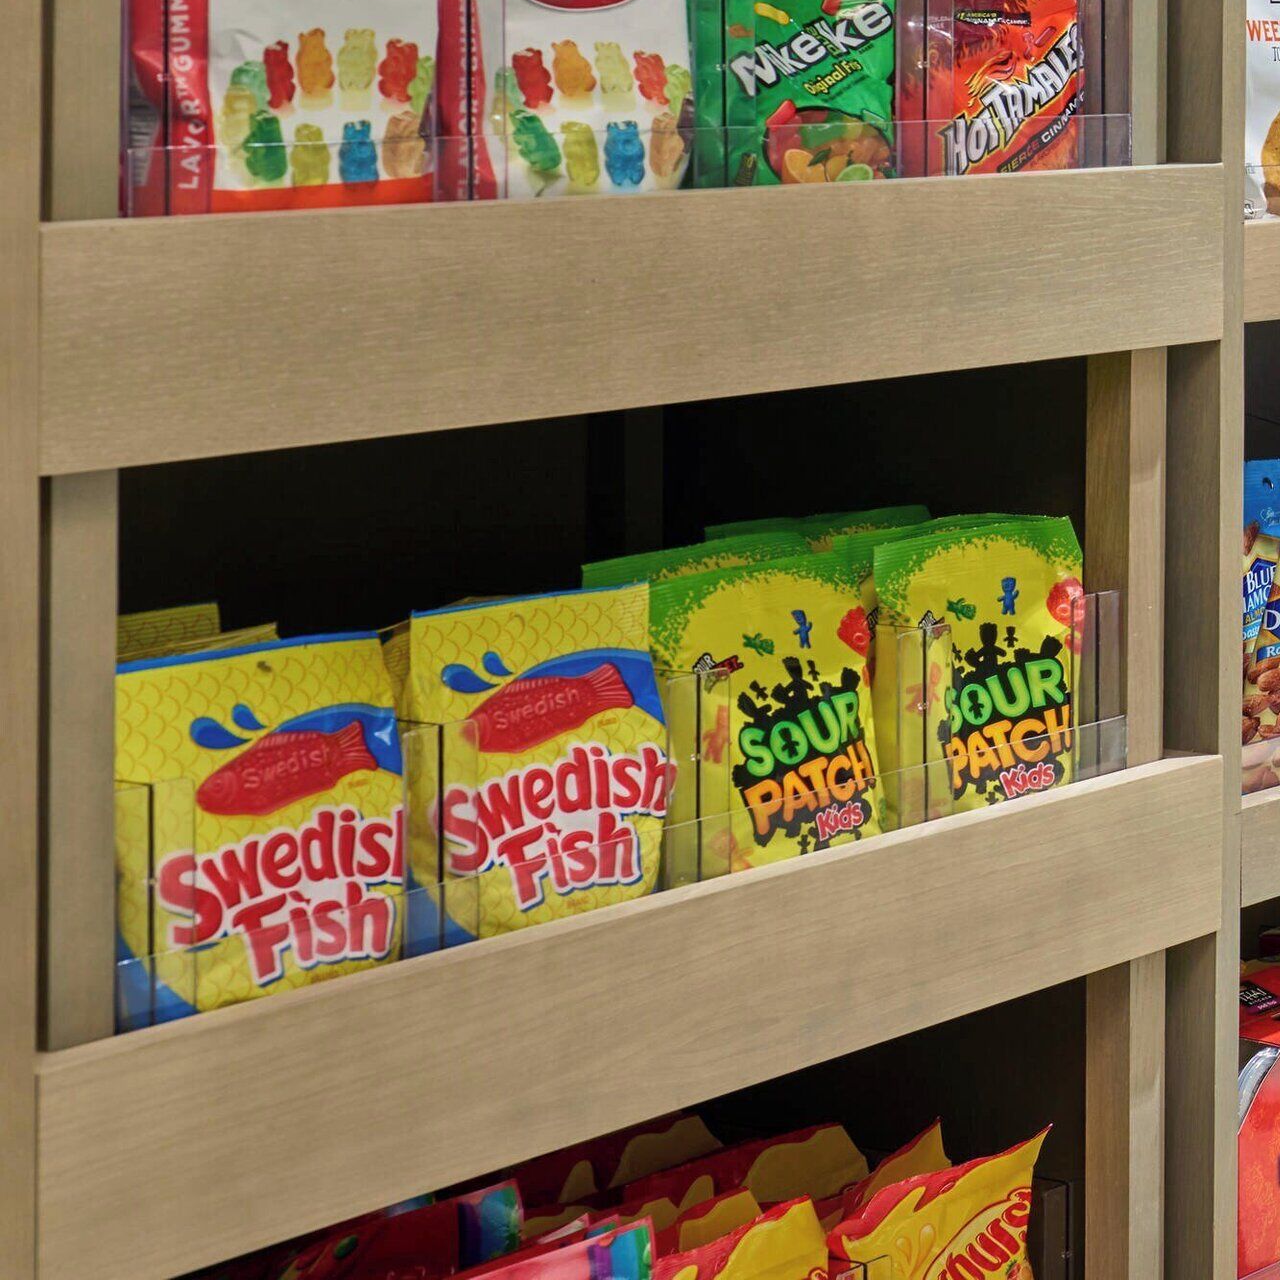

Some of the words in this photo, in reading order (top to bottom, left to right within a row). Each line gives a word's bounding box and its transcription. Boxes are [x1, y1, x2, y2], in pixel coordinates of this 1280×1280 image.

[944, 112, 1001, 176] HOT
[740, 691, 859, 775] SOUR
[947, 658, 1064, 732] SOUR
[744, 740, 874, 836] PATCH
[947, 705, 1072, 789] PATCH
[999, 762, 1055, 799] Kids
[445, 746, 676, 871] Swedish
[816, 803, 863, 840] Kids
[498, 814, 639, 908] Fish
[234, 885, 391, 981] Fish
